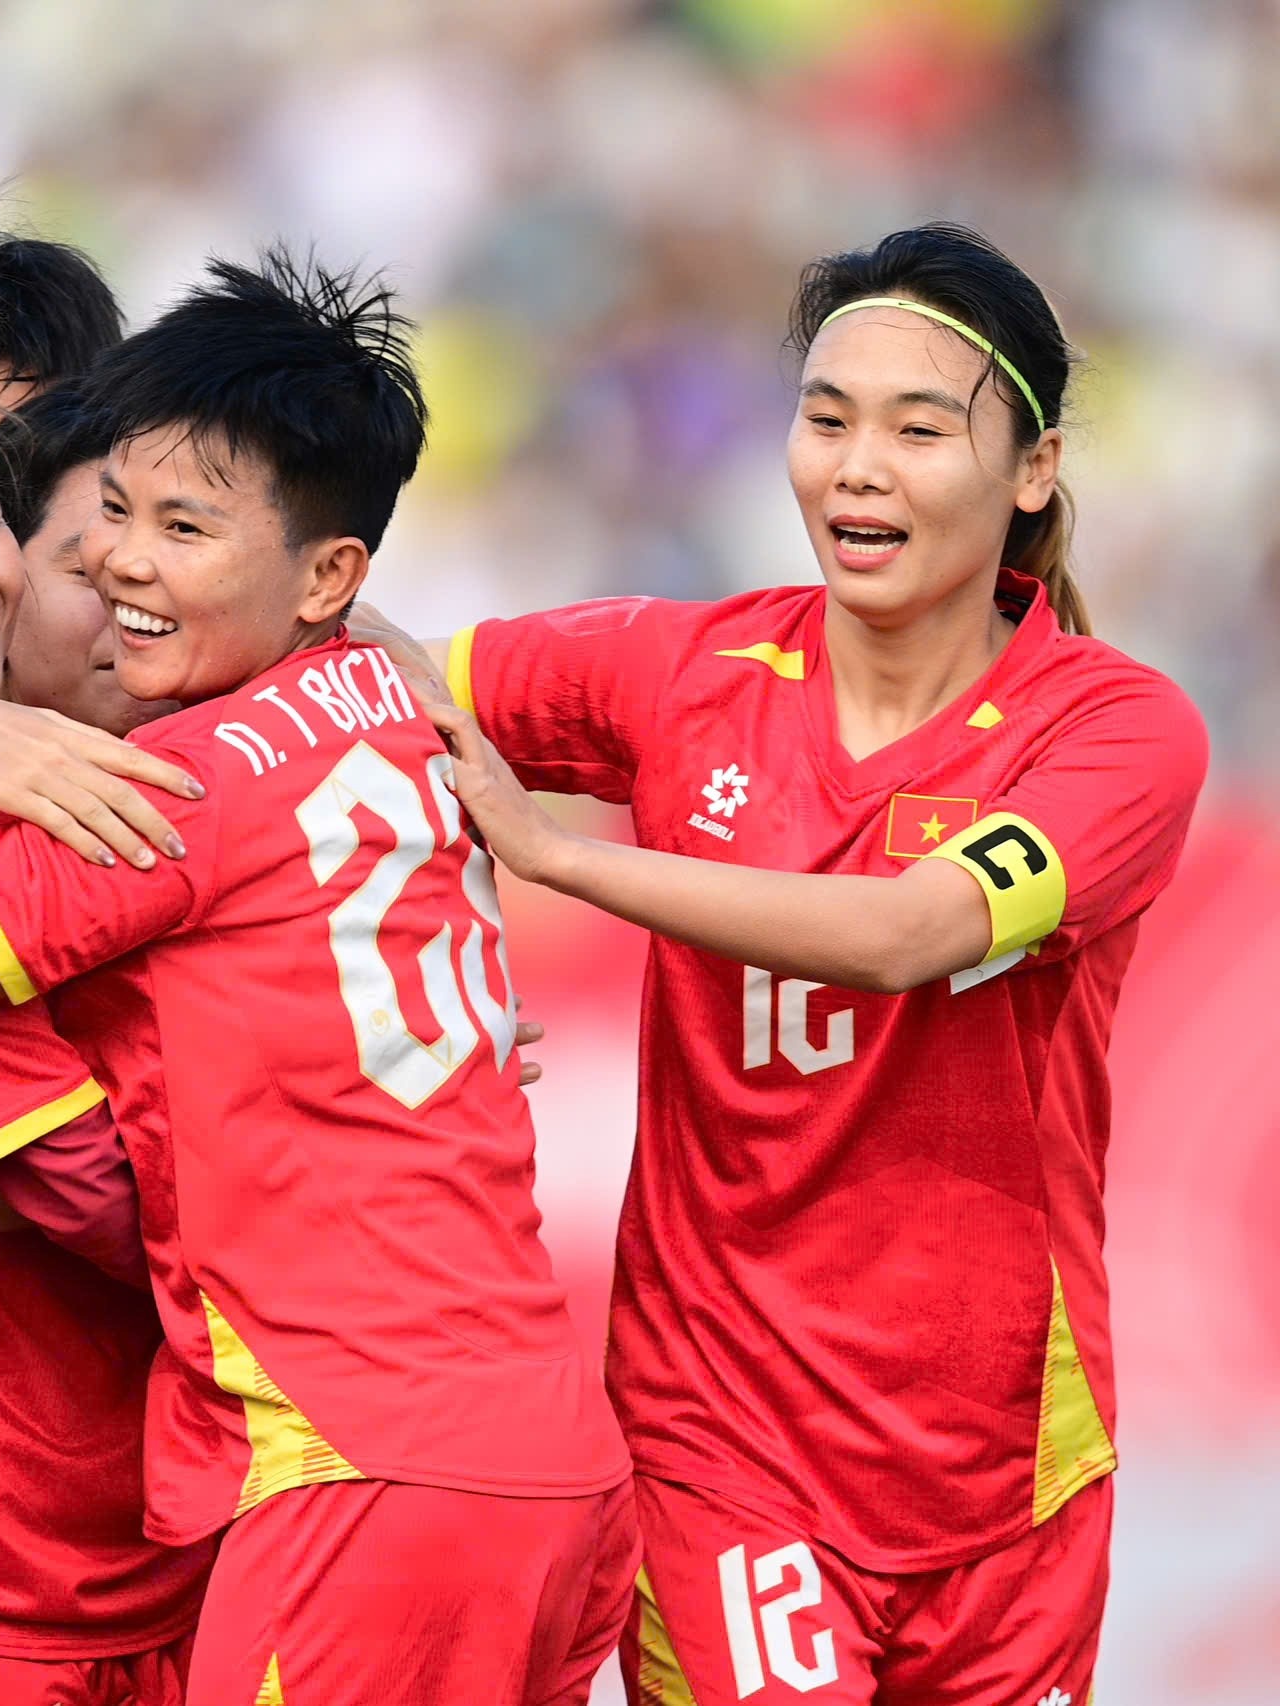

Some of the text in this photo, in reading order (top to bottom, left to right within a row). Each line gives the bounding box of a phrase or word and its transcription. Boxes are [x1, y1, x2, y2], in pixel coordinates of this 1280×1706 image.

[252, 685, 318, 748] T
[297, 647, 416, 734] BICH
[961, 824, 1048, 890] C
[717, 1540, 840, 1701] 12
